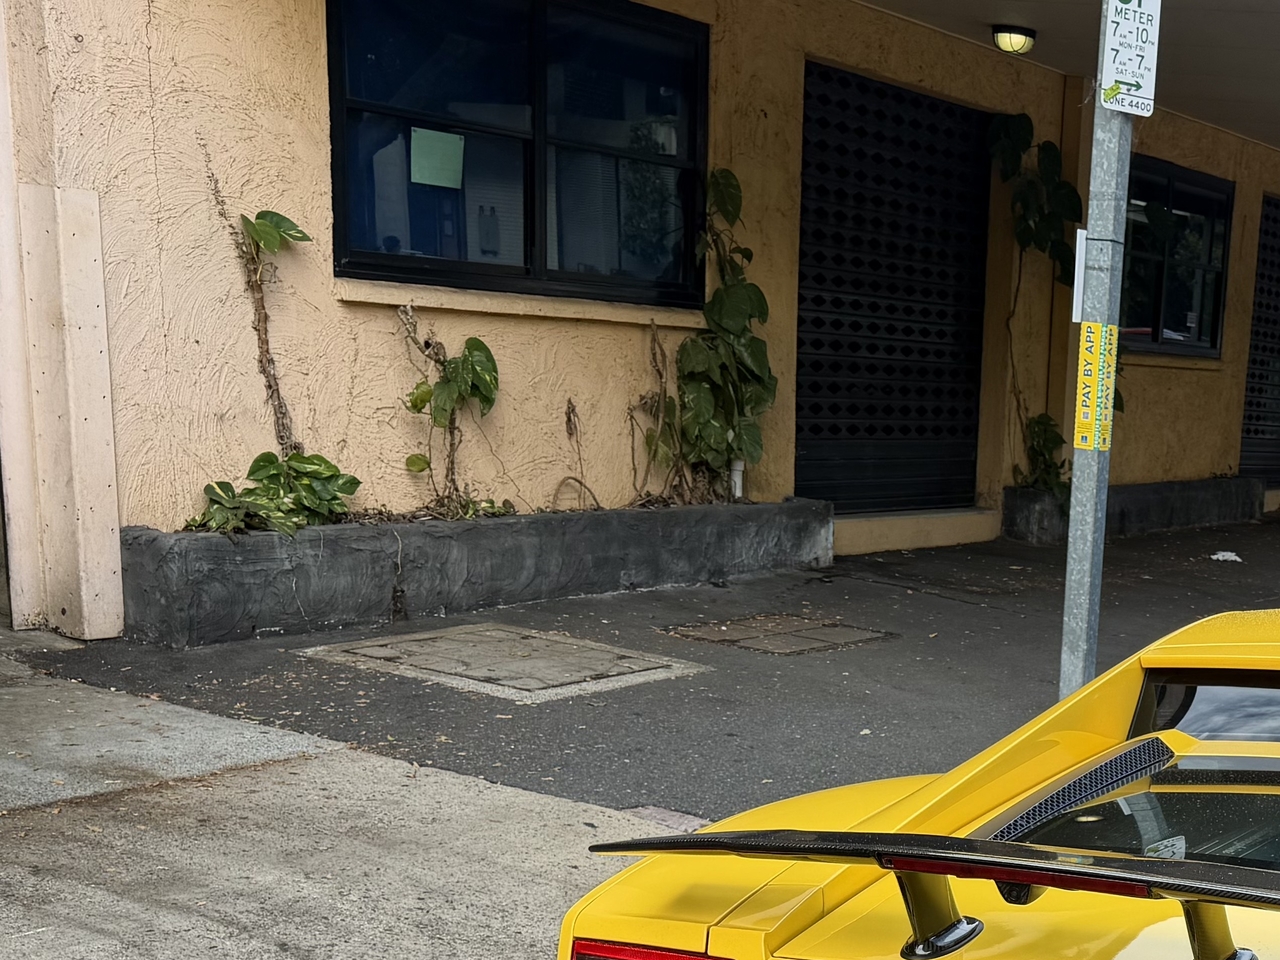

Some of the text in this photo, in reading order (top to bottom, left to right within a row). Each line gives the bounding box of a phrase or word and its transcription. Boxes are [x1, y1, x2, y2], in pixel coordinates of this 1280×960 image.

[1114, 5, 1154, 27] METER
[1128, 99, 1152, 113] 4400
[1081, 325, 1095, 408] PAY BY APP
[1106, 361, 1112, 379] BY
